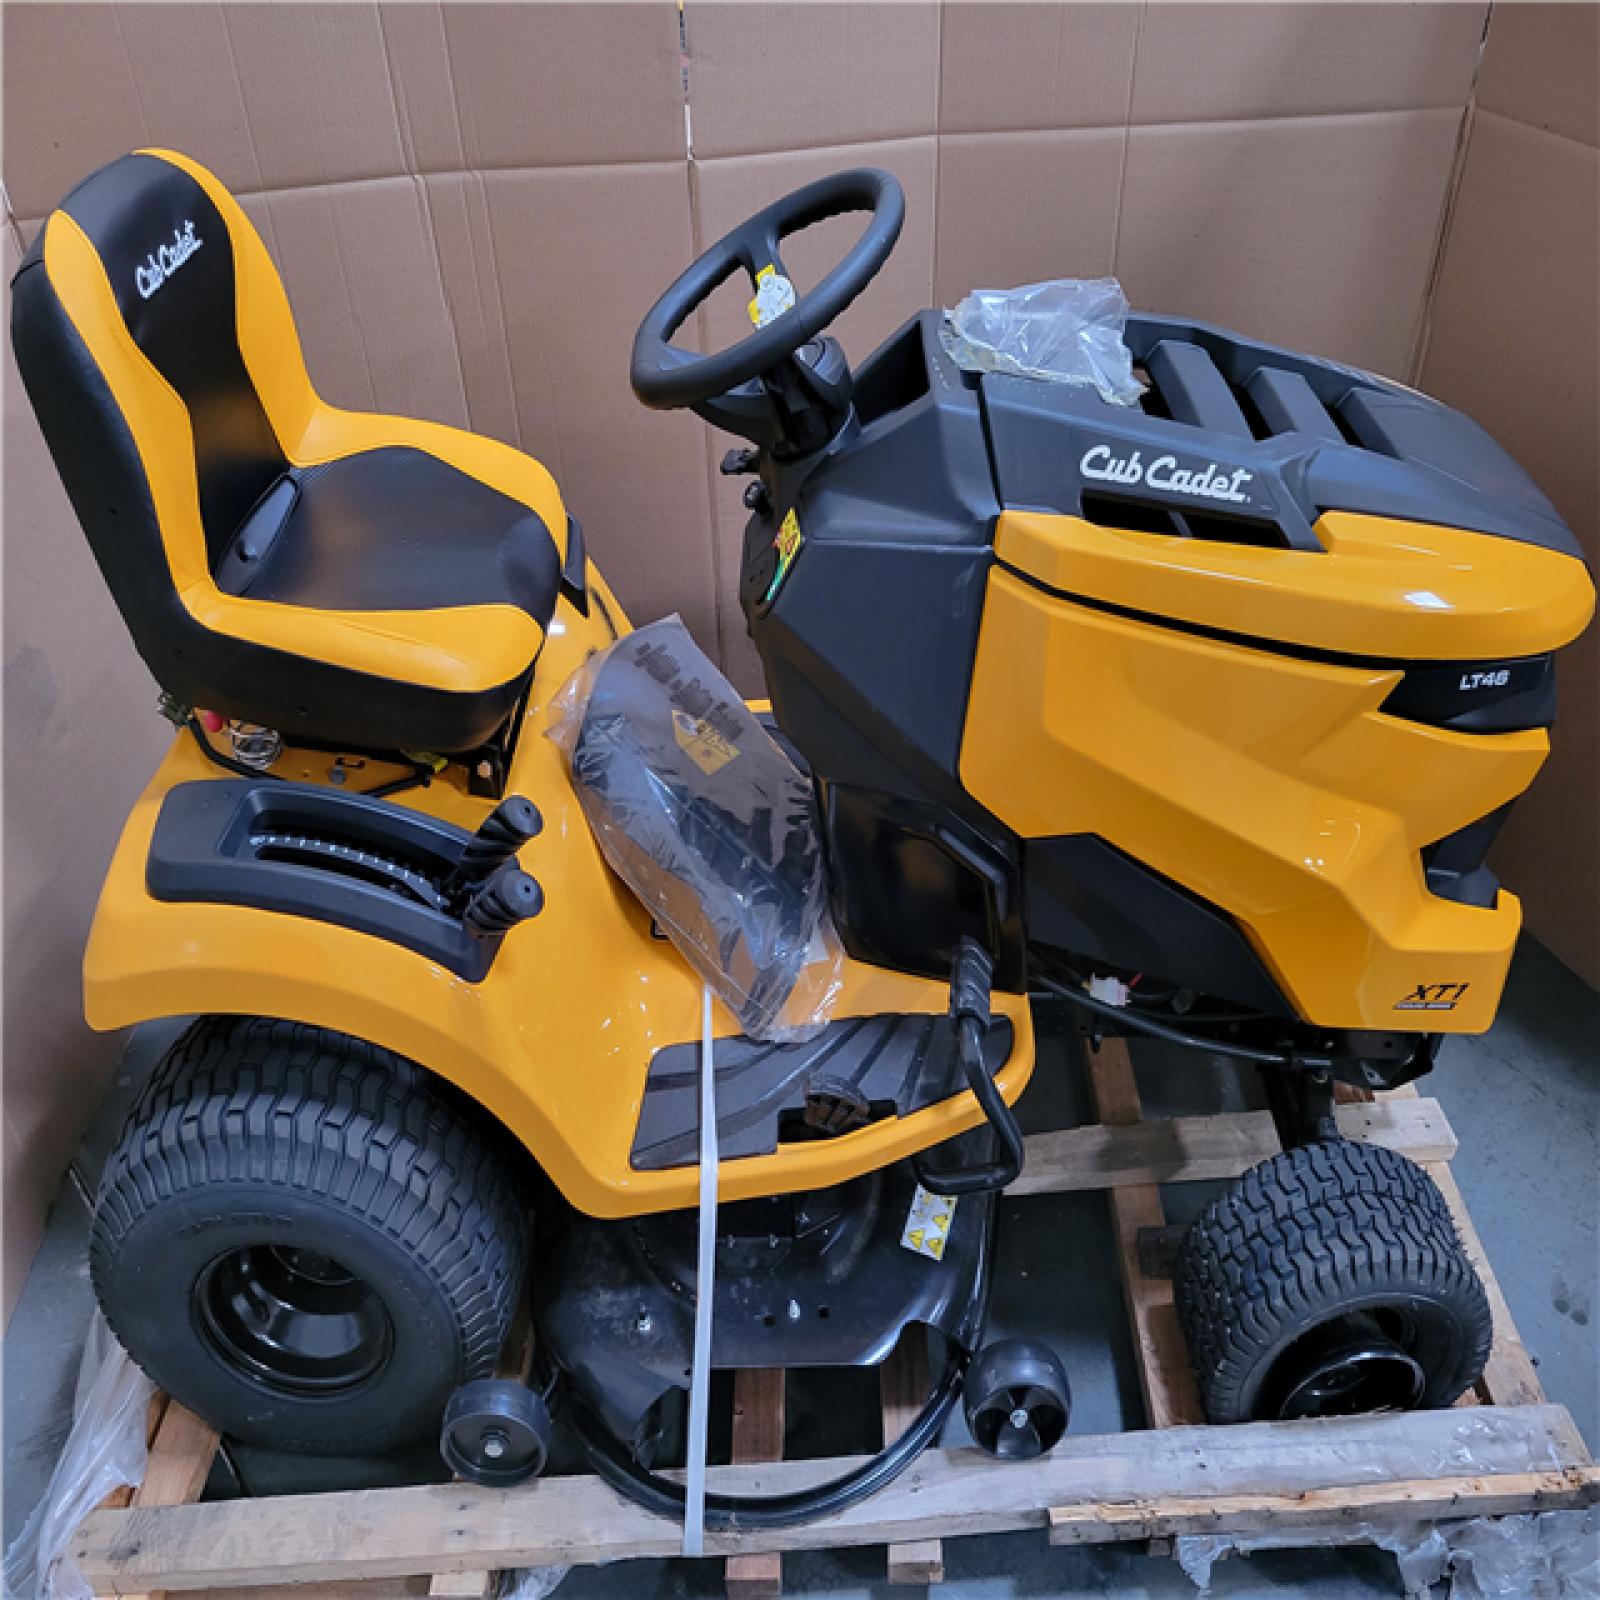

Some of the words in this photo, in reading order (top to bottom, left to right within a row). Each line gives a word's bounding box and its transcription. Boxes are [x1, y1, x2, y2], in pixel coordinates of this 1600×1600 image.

[135, 253, 166, 299] Cub
[158, 219, 203, 276] Cadet
[1080, 445, 1143, 484] Cub
[1145, 456, 1253, 503] Cadet
[1404, 982, 1470, 1001] XT1
